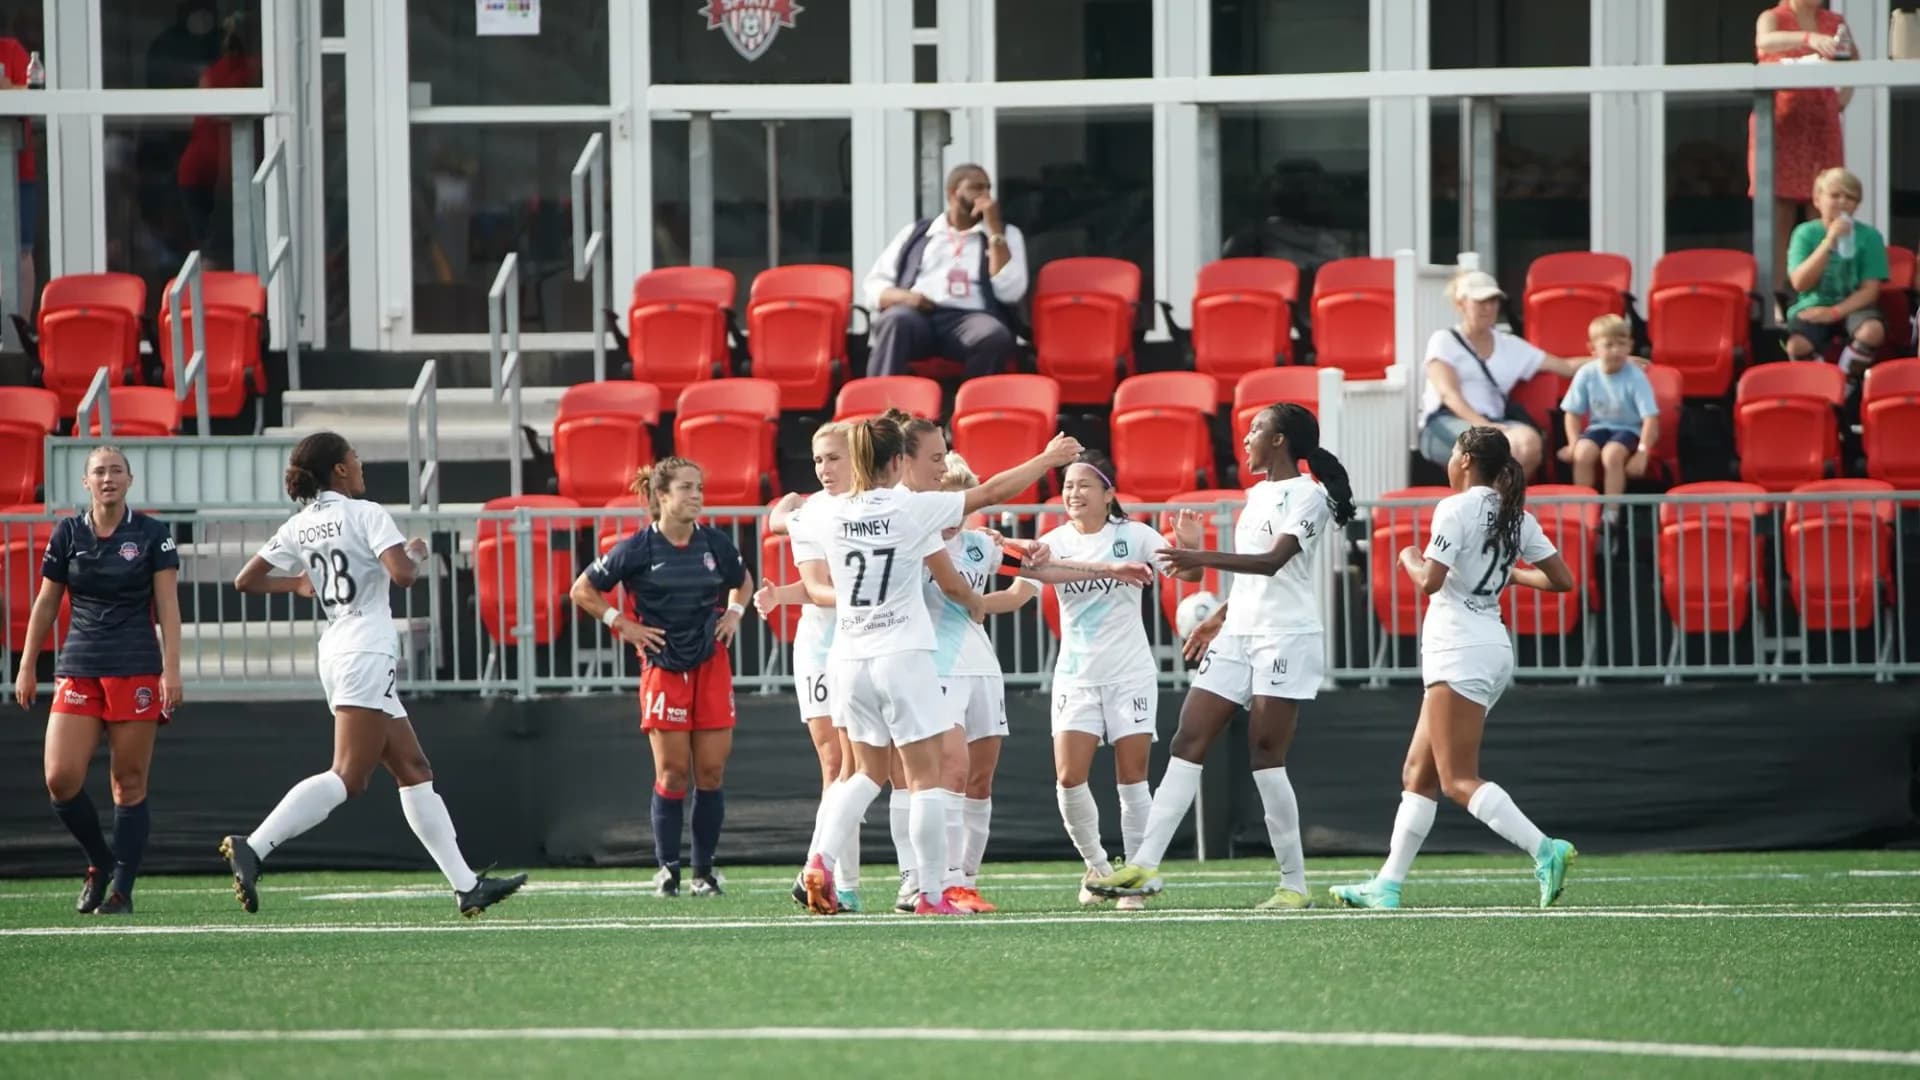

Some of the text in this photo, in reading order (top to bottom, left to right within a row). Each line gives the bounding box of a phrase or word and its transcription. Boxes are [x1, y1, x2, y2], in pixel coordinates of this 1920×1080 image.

[299, 520, 343, 544] DORSEY
[842, 519, 890, 538] THINEY
[1299, 519, 1316, 539] ally
[160, 537, 176, 552] all
[1434, 534, 1451, 553] lly
[310, 549, 357, 607] 28
[845, 547, 895, 607] 27
[1273, 658, 1288, 674] NY
[806, 673, 828, 704] 16
[645, 691, 665, 720] 14
[1133, 697, 1148, 712] NY
